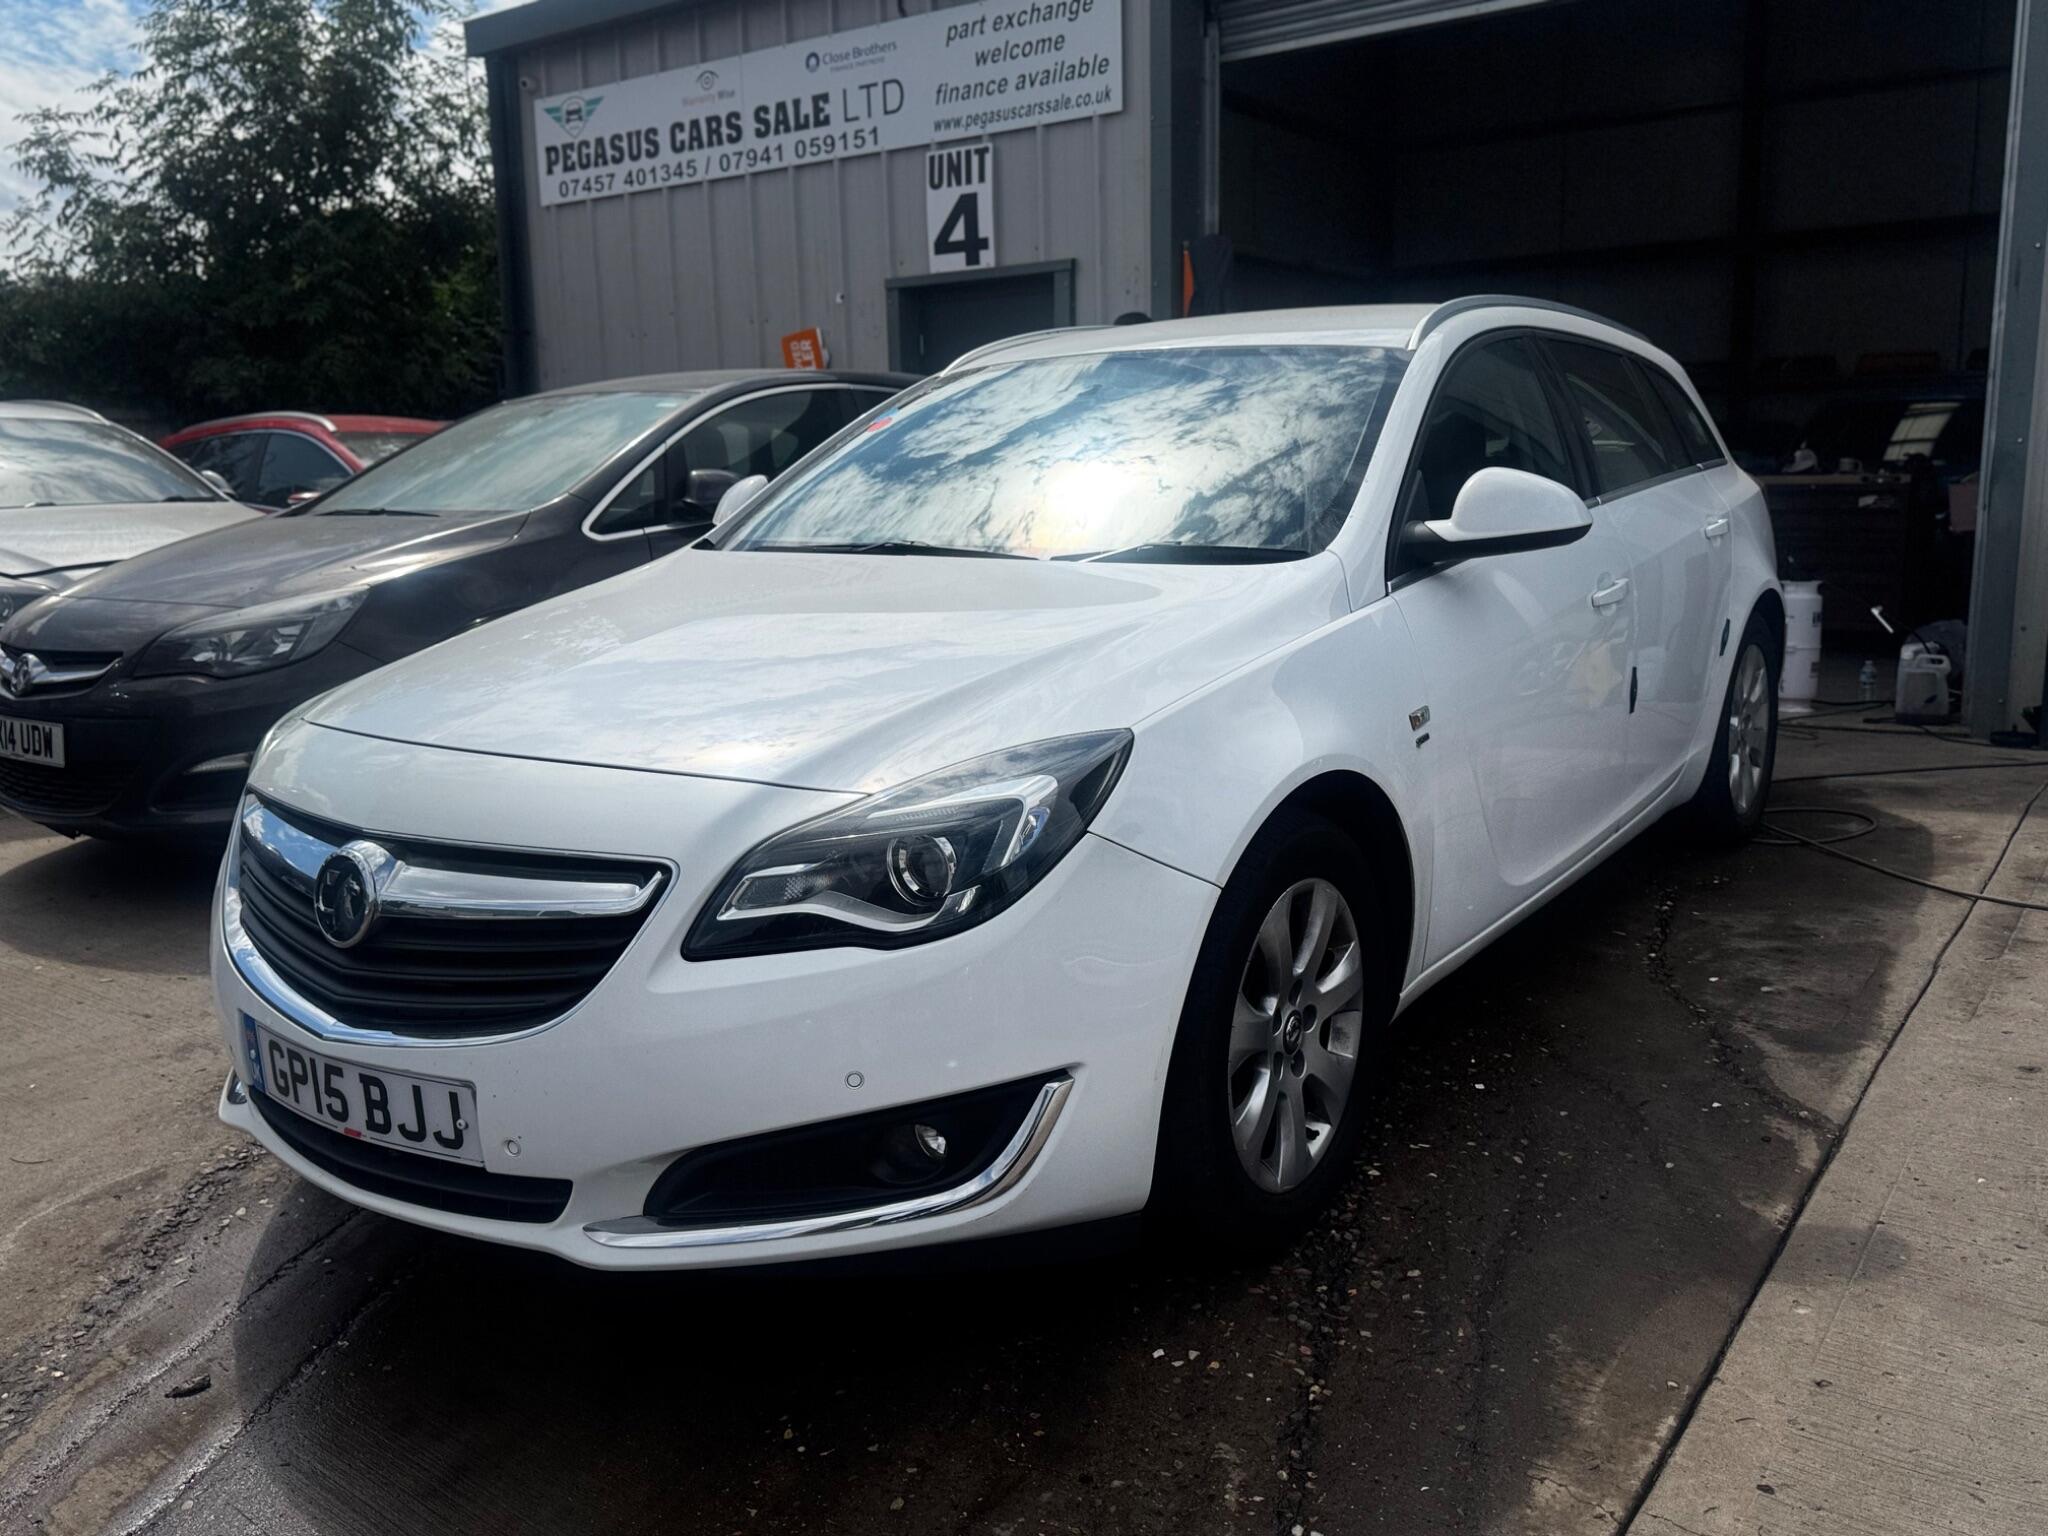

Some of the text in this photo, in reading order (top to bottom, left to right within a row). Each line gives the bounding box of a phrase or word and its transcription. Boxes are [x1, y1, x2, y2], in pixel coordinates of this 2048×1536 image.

[946, 0, 1094, 47] part exchange
[975, 34, 1065, 67] welcome
[935, 54, 1110, 106] finance available
[545, 78, 904, 175] PEGASUS CARS SALE LTD
[933, 85, 1112, 132] www.pegasuscarssale.co.uk
[559, 172, 616, 198] 07457
[623, 159, 698, 187] 401345
[719, 143, 785, 173] 07941
[794, 126, 880, 160] 059151
[928, 146, 990, 190] UNIT
[934, 192, 989, 267] 4
[20, 722, 53, 759] UDW
[359, 1072, 464, 1149] BJJ
